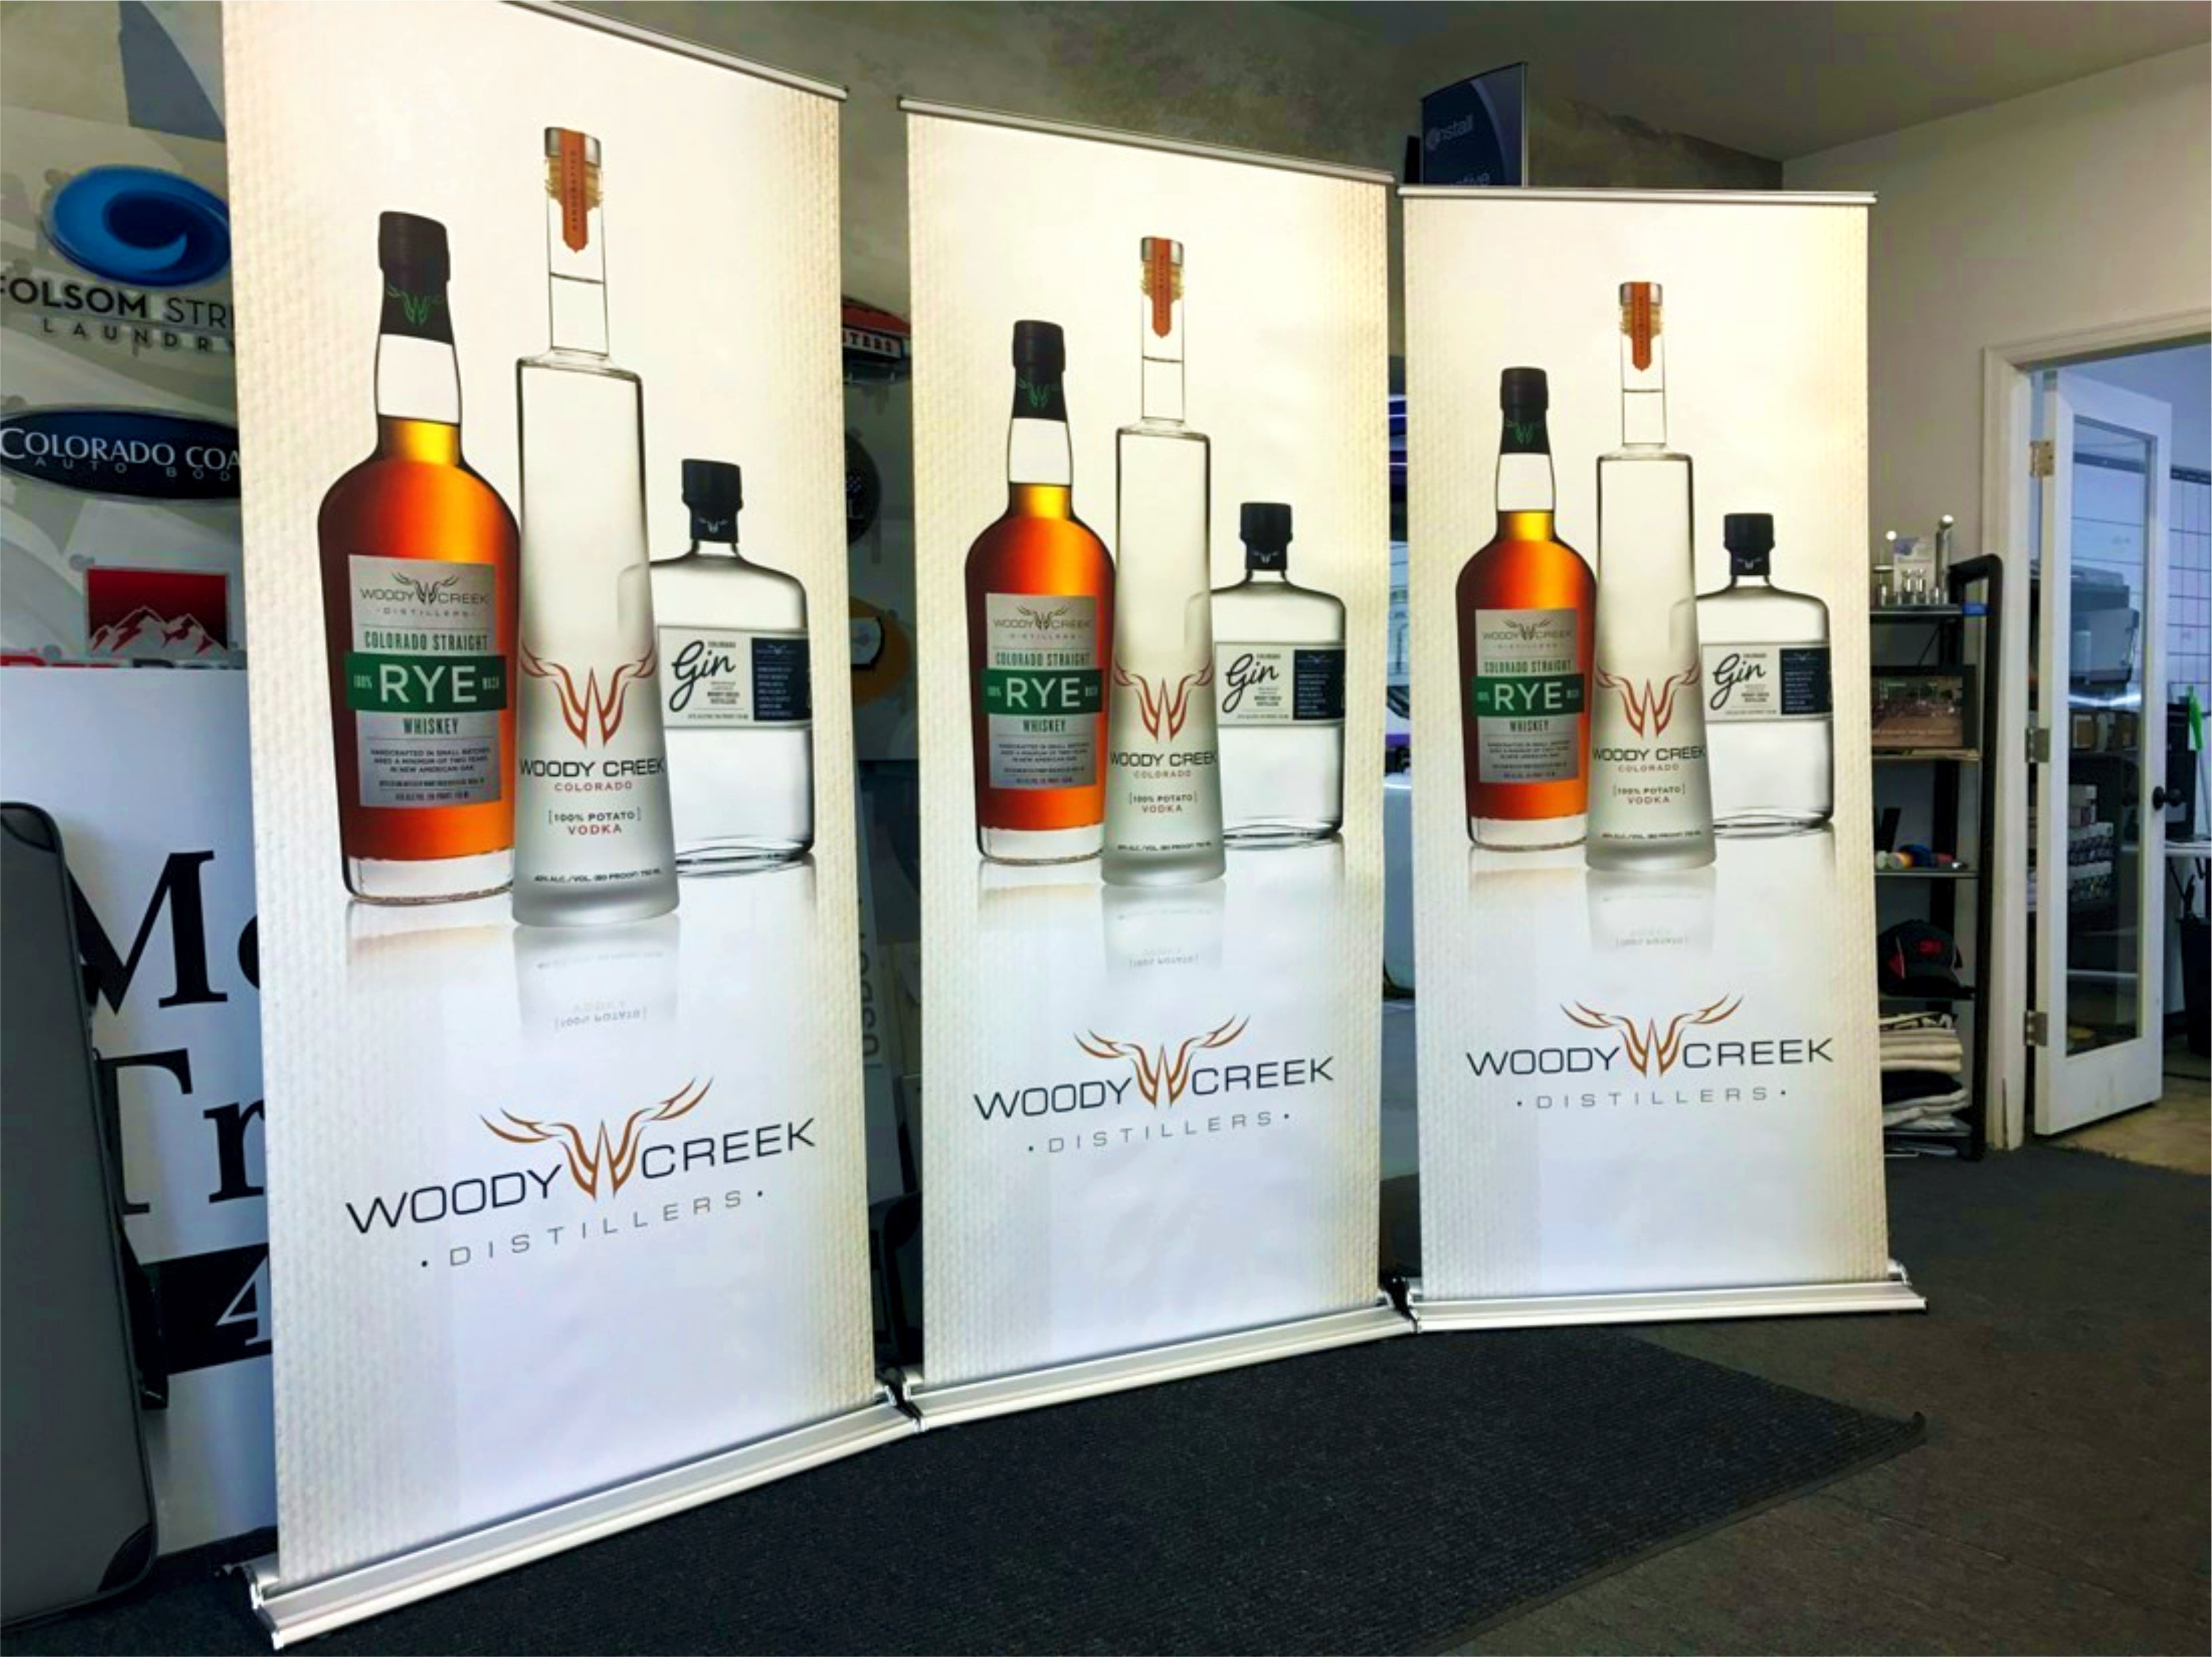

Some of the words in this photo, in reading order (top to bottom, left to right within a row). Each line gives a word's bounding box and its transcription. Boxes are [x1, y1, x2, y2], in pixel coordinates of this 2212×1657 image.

[0, 276, 146, 318] OLSOM
[166, 296, 235, 328] STR
[0, 427, 175, 466] COLORADO
[360, 588, 414, 601] WOODY
[438, 592, 489, 604] CREEK
[365, 631, 427, 650] COLORADO
[433, 635, 488, 651] STRAIGHT
[379, 663, 477, 703] RYE
[669, 639, 736, 712] Gin
[1222, 653, 1279, 714] Gin
[1710, 653, 1766, 711] Gin
[1006, 677, 1081, 708] RYE
[1494, 681, 1563, 711] RYE
[403, 718, 459, 734] WHISKEY
[1110, 752, 1165, 767] WOODY
[1169, 751, 1217, 767] CREEK
[1592, 748, 1651, 761] WOODY
[1656, 746, 1706, 761] CREEK
[520, 760, 595, 778] WOODY
[603, 758, 665, 778] CREEK
[1133, 769, 1192, 778] COLORADO
[1618, 764, 1679, 773] COLORADO
[554, 780, 632, 792] COLORADO
[1142, 804, 1183, 813] VODKA
[1627, 796, 1671, 805] VODKA
[568, 824, 622, 836] VODKA
[1466, 1046, 1621, 1076] WOODY
[1683, 1038, 1834, 1070] CREEK
[974, 1077, 1133, 1120] WOODY
[1191, 1056, 1334, 1095] CREEK
[1536, 1087, 1767, 1109] DISTILLERS
[1048, 1111, 1272, 1153] DISTILLERS
[345, 1163, 563, 1235] WOODY
[641, 1117, 817, 1180] CREEK
[449, 1189, 743, 1267] DISTILLERS
